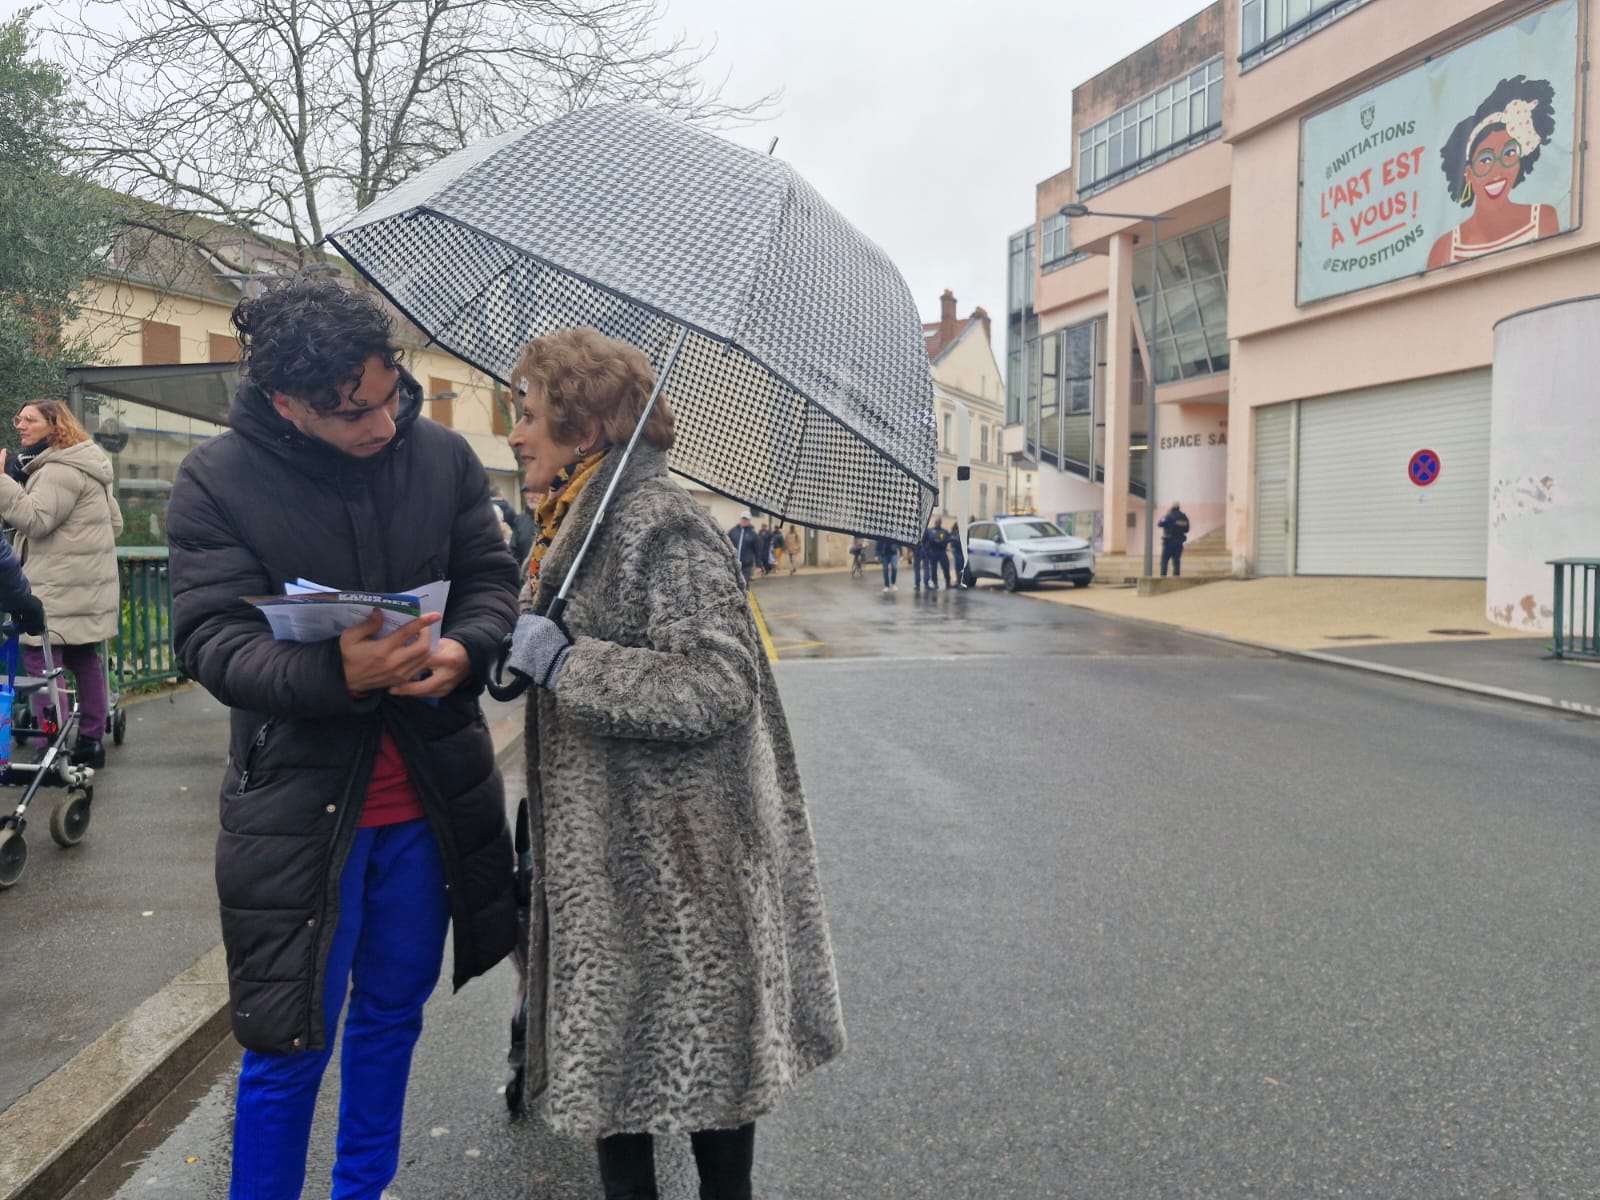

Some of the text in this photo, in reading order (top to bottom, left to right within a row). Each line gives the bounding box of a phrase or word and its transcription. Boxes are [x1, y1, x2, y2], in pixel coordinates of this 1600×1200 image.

[1320, 145, 1426, 218] L'ART EST
[1331, 222, 1345, 249] À
[1160, 433, 1201, 450] ESPACE
